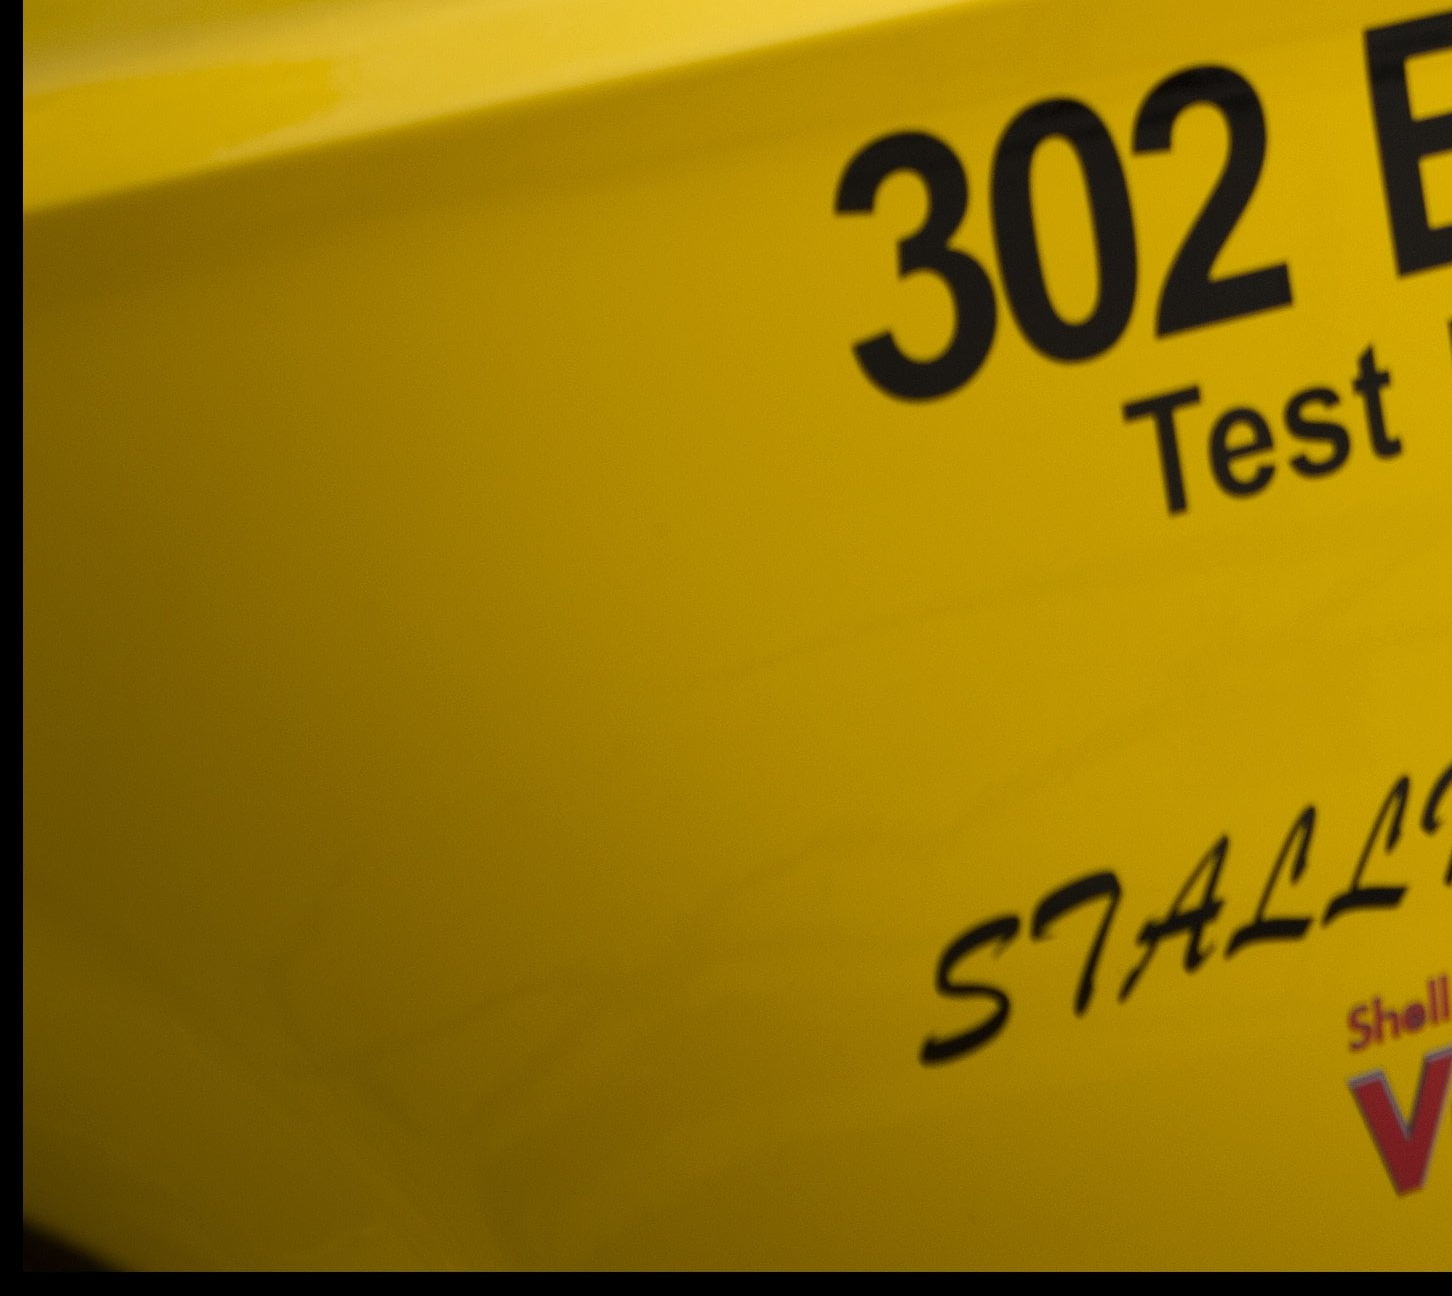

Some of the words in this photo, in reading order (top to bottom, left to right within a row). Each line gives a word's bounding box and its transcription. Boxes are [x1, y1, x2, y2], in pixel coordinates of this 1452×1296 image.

[833, 63, 1295, 403] 302
[1122, 343, 1403, 517] Test
[1346, 974, 1452, 1053] Shell
